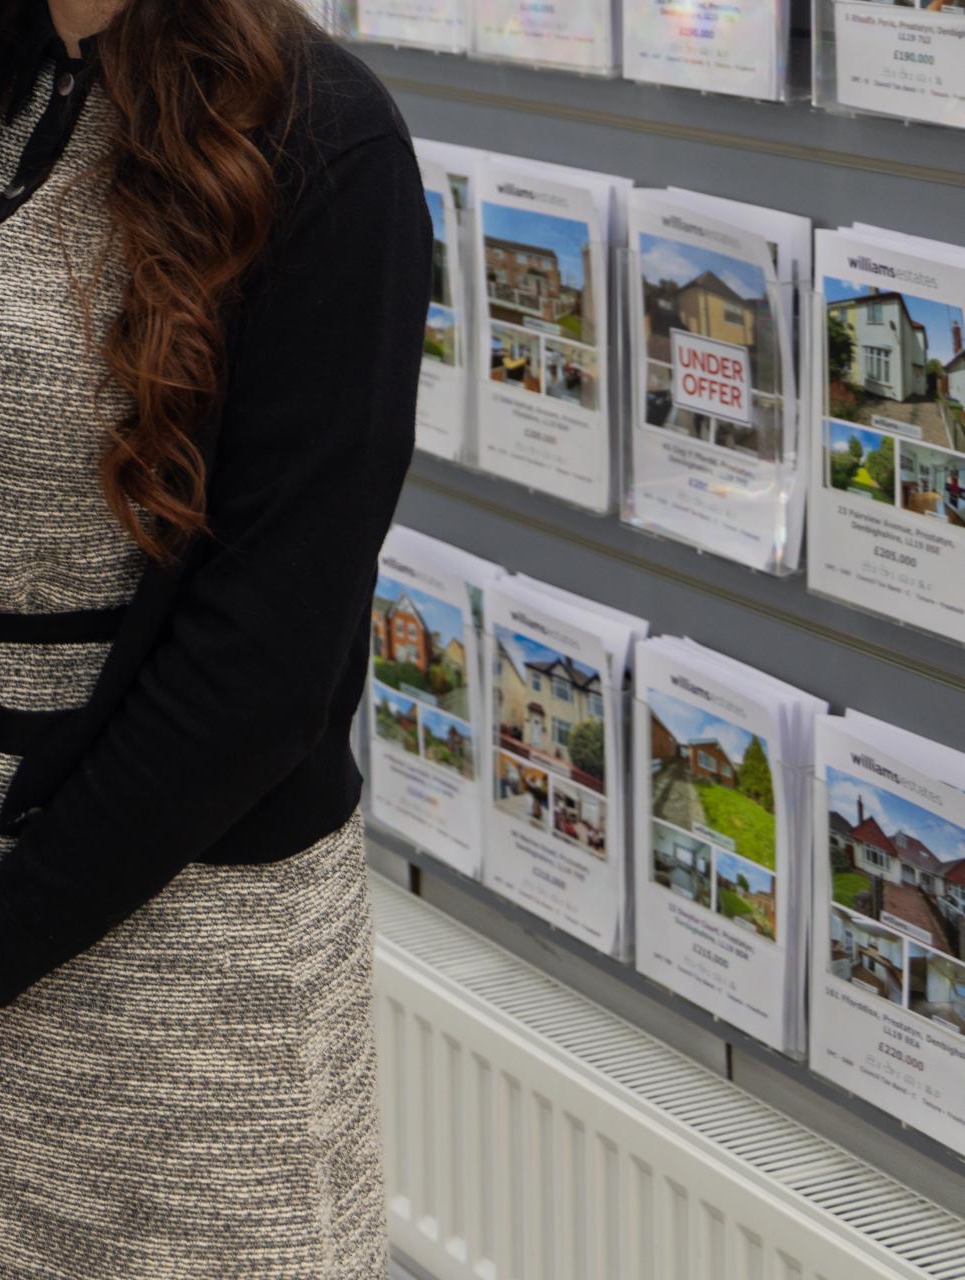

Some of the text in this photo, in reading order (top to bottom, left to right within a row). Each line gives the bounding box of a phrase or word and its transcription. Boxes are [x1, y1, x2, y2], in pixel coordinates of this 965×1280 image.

[847, 255, 896, 278] williams
[678, 345, 744, 383] UNDER
[682, 373, 742, 409] OFFER
[850, 752, 900, 784] williams
